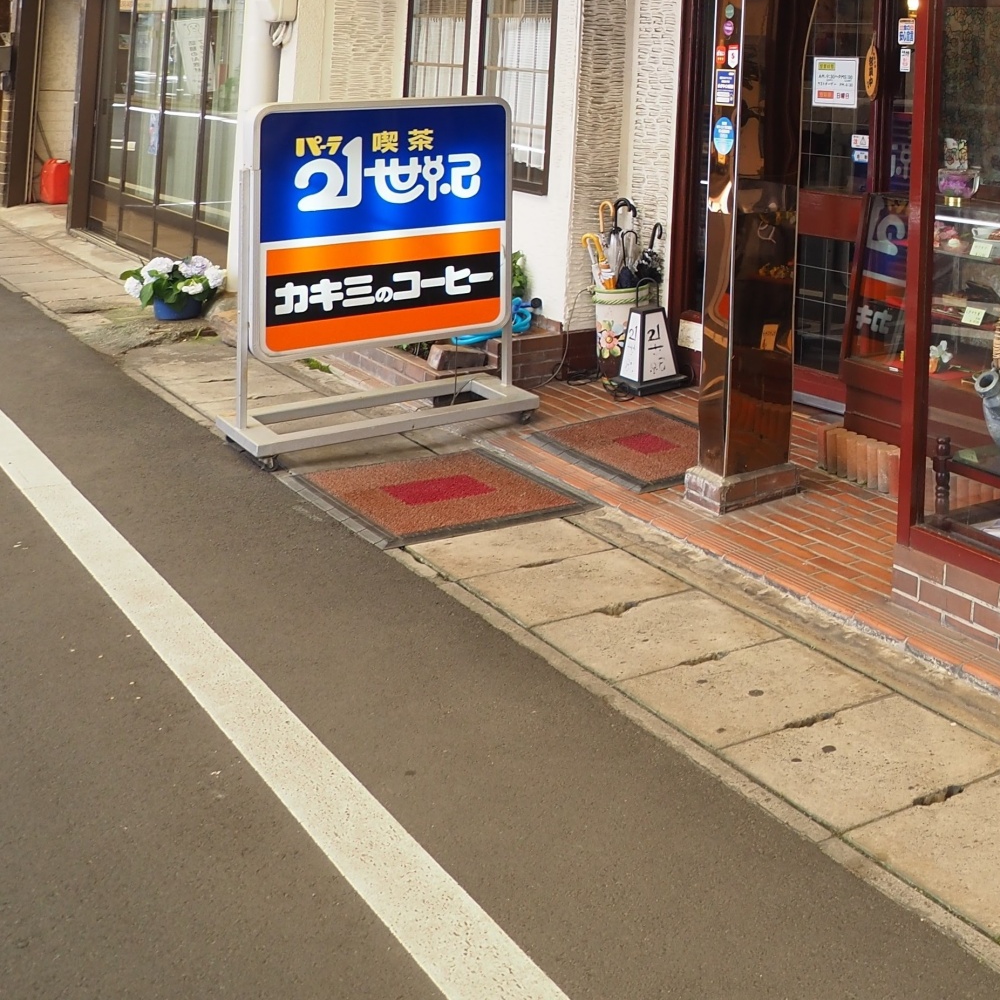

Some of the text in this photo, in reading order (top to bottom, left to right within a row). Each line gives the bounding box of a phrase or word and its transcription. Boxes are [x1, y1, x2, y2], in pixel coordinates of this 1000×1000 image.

[295, 128, 434, 157] パーラ 喫茶
[294, 136, 482, 212] 21世紀
[274, 265, 494, 316] カキミのコーヒー
